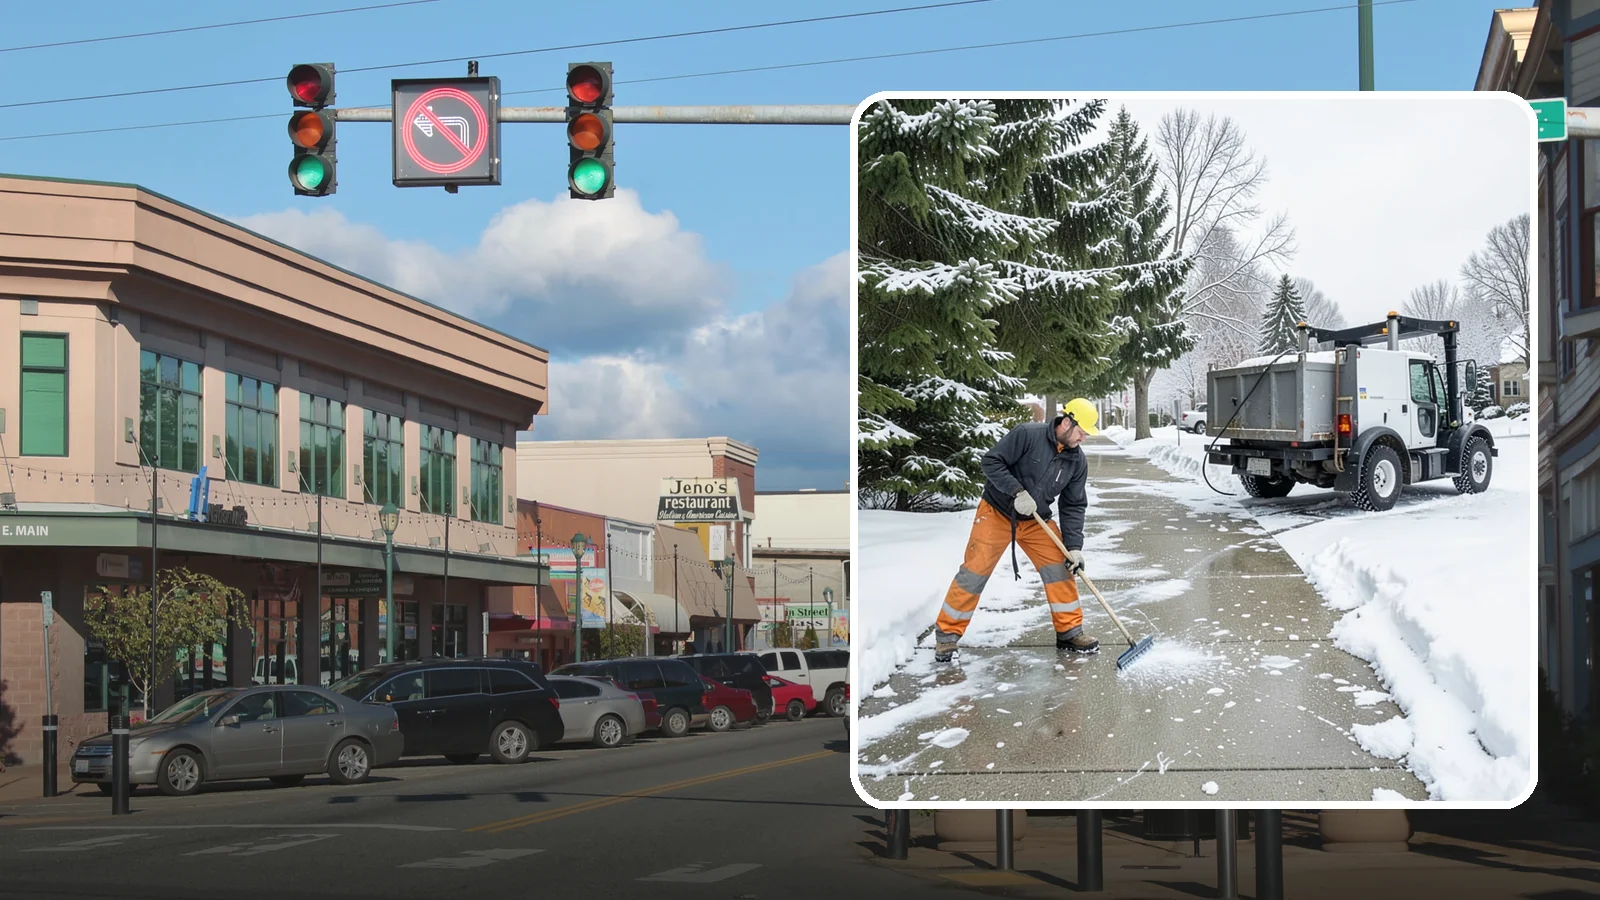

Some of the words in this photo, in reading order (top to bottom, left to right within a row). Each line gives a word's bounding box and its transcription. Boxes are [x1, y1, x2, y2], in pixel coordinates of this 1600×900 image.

[670, 480, 727, 494] Jeno's
[664, 496, 731, 509] restaurant
[658, 510, 681, 519] Italian
[686, 509, 714, 519] American
[715, 510, 737, 519] Cuisine
[2, 525, 13, 536] E.
[15, 525, 49, 536] MAIN
[797, 608, 828, 616] Street
